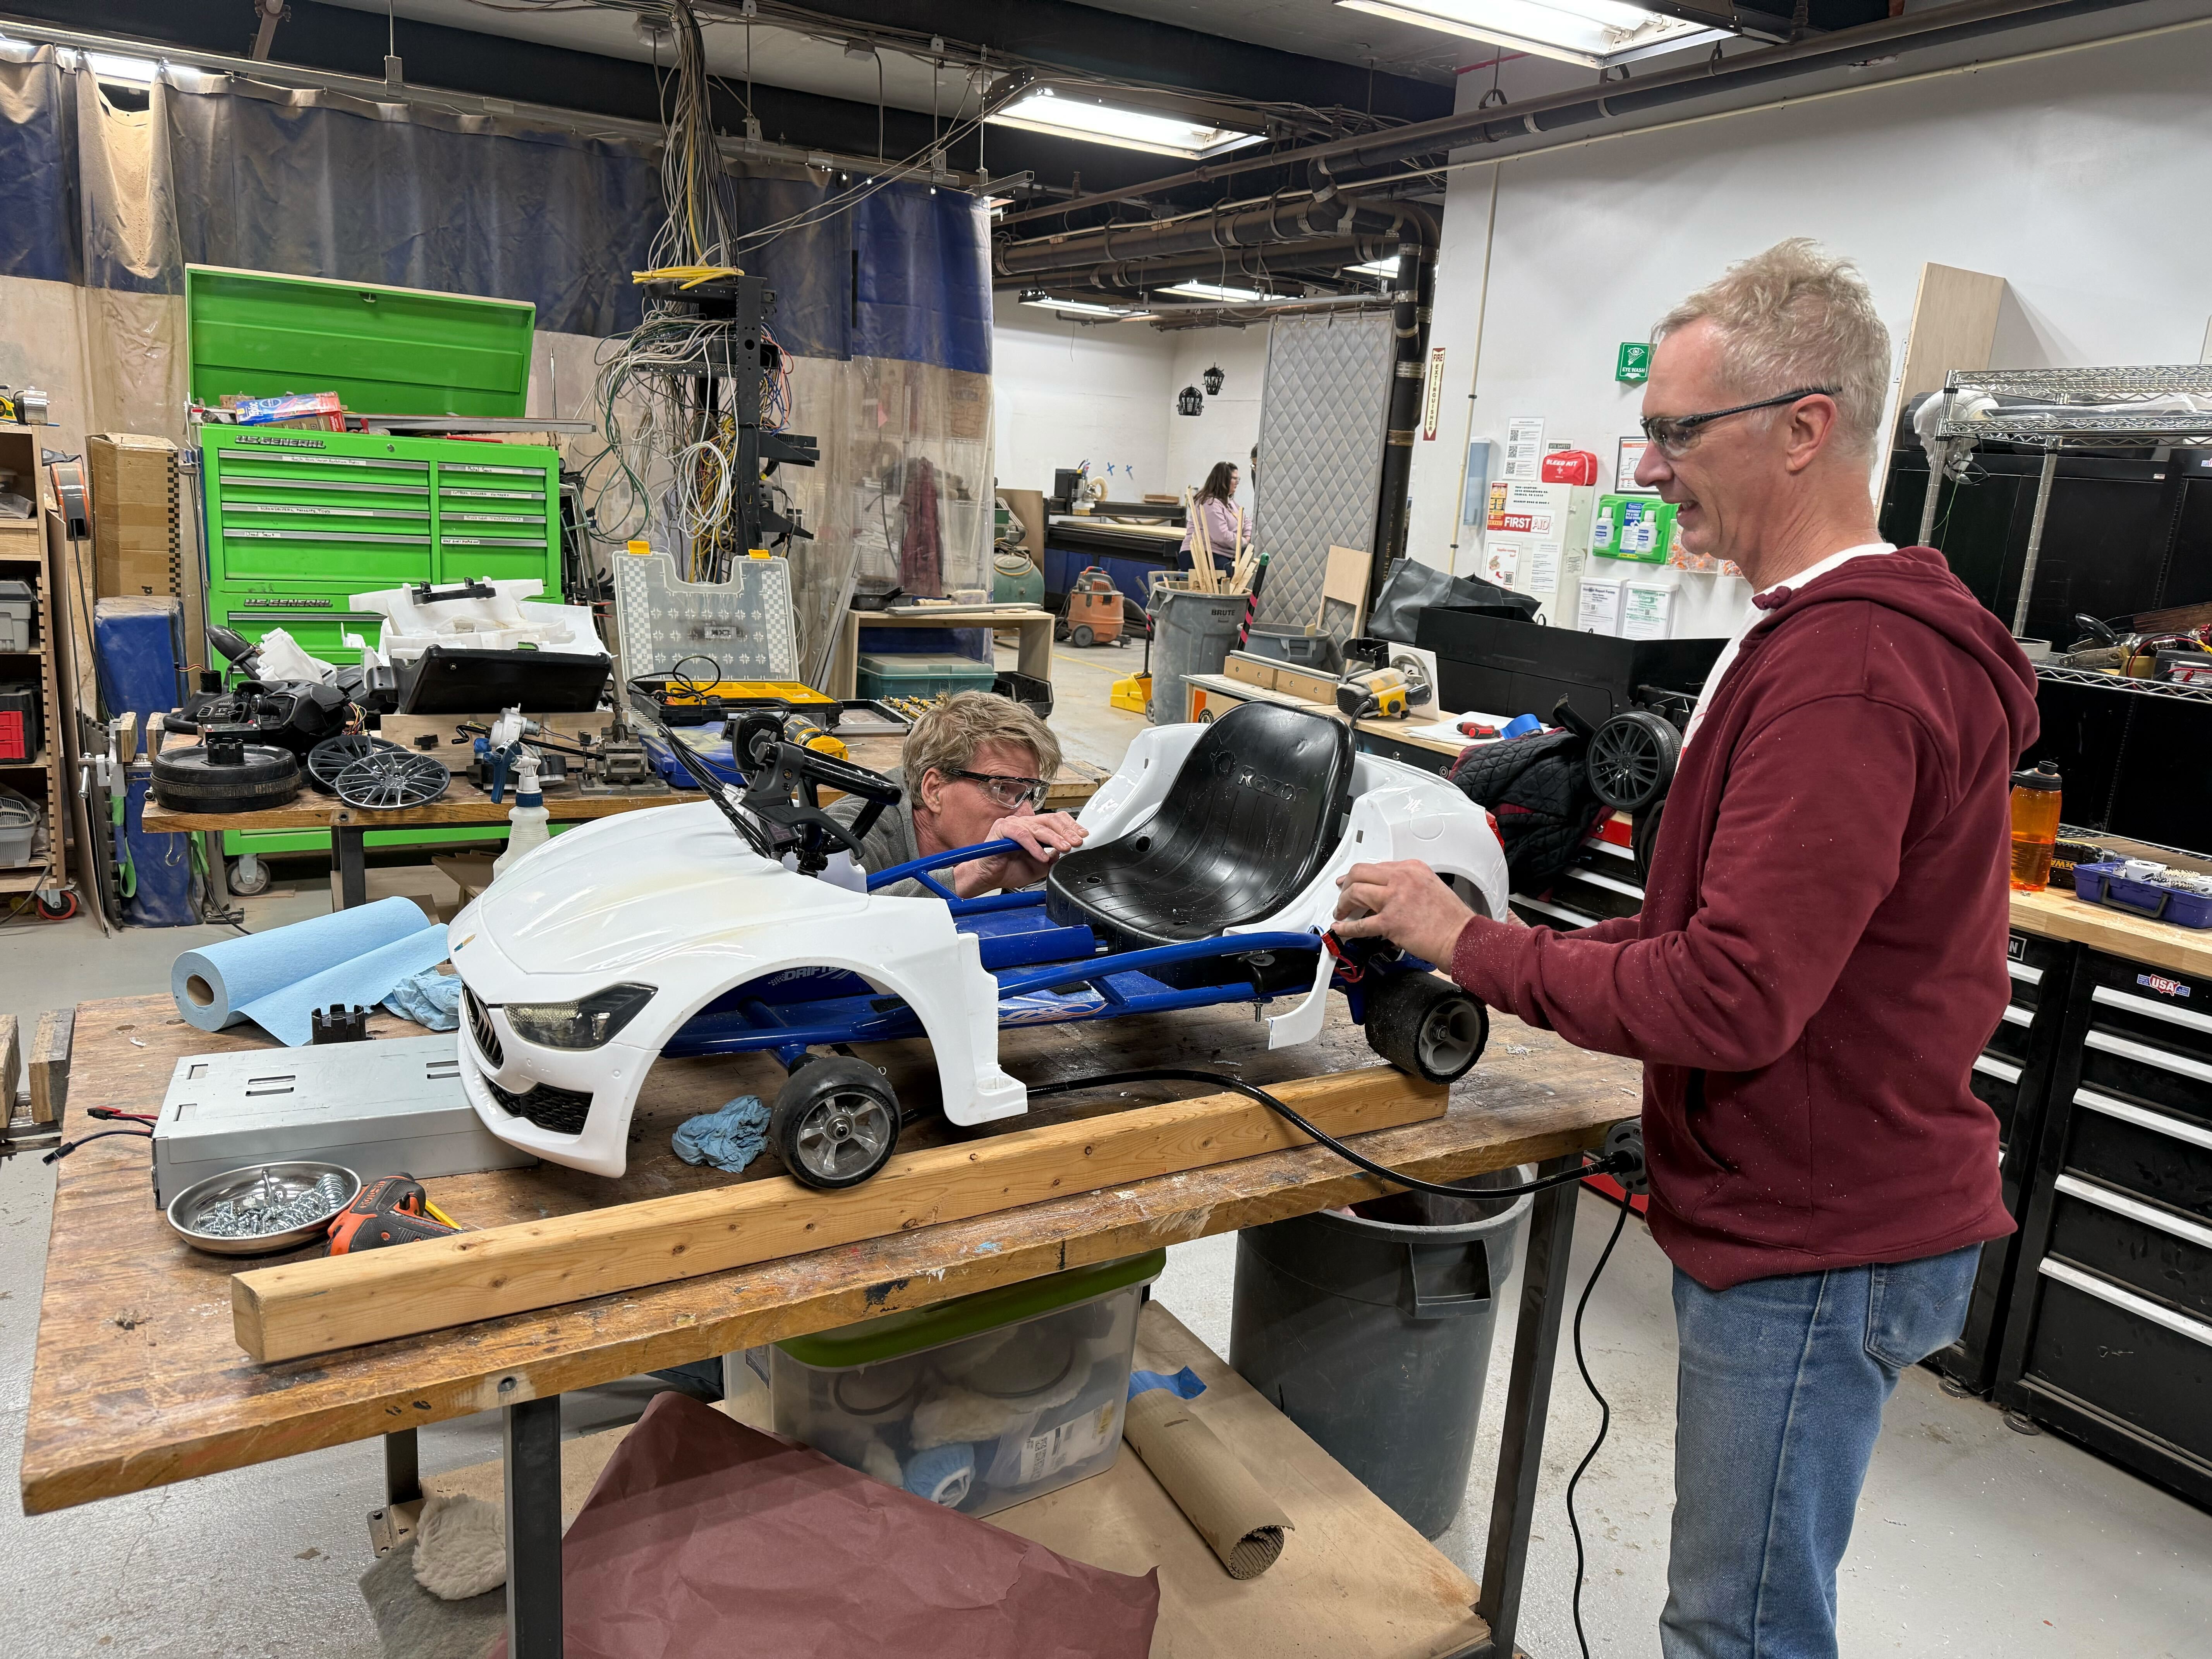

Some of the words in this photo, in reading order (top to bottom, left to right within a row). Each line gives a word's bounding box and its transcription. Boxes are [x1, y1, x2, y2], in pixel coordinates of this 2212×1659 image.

[1433, 354, 1443, 362] FIRE
[1429, 364, 1439, 431] EXTINGUISHER
[260, 436, 326, 449] GENERAL
[1504, 517, 1531, 529] FIRST
[1532, 518, 1549, 530] AID
[268, 599, 333, 607] GENERAL
[1237, 765, 1309, 802] Razor
[2051, 859, 2076, 870] DEWA
[2152, 977, 2174, 992] USA
[874, 1093, 892, 1116] Razor
